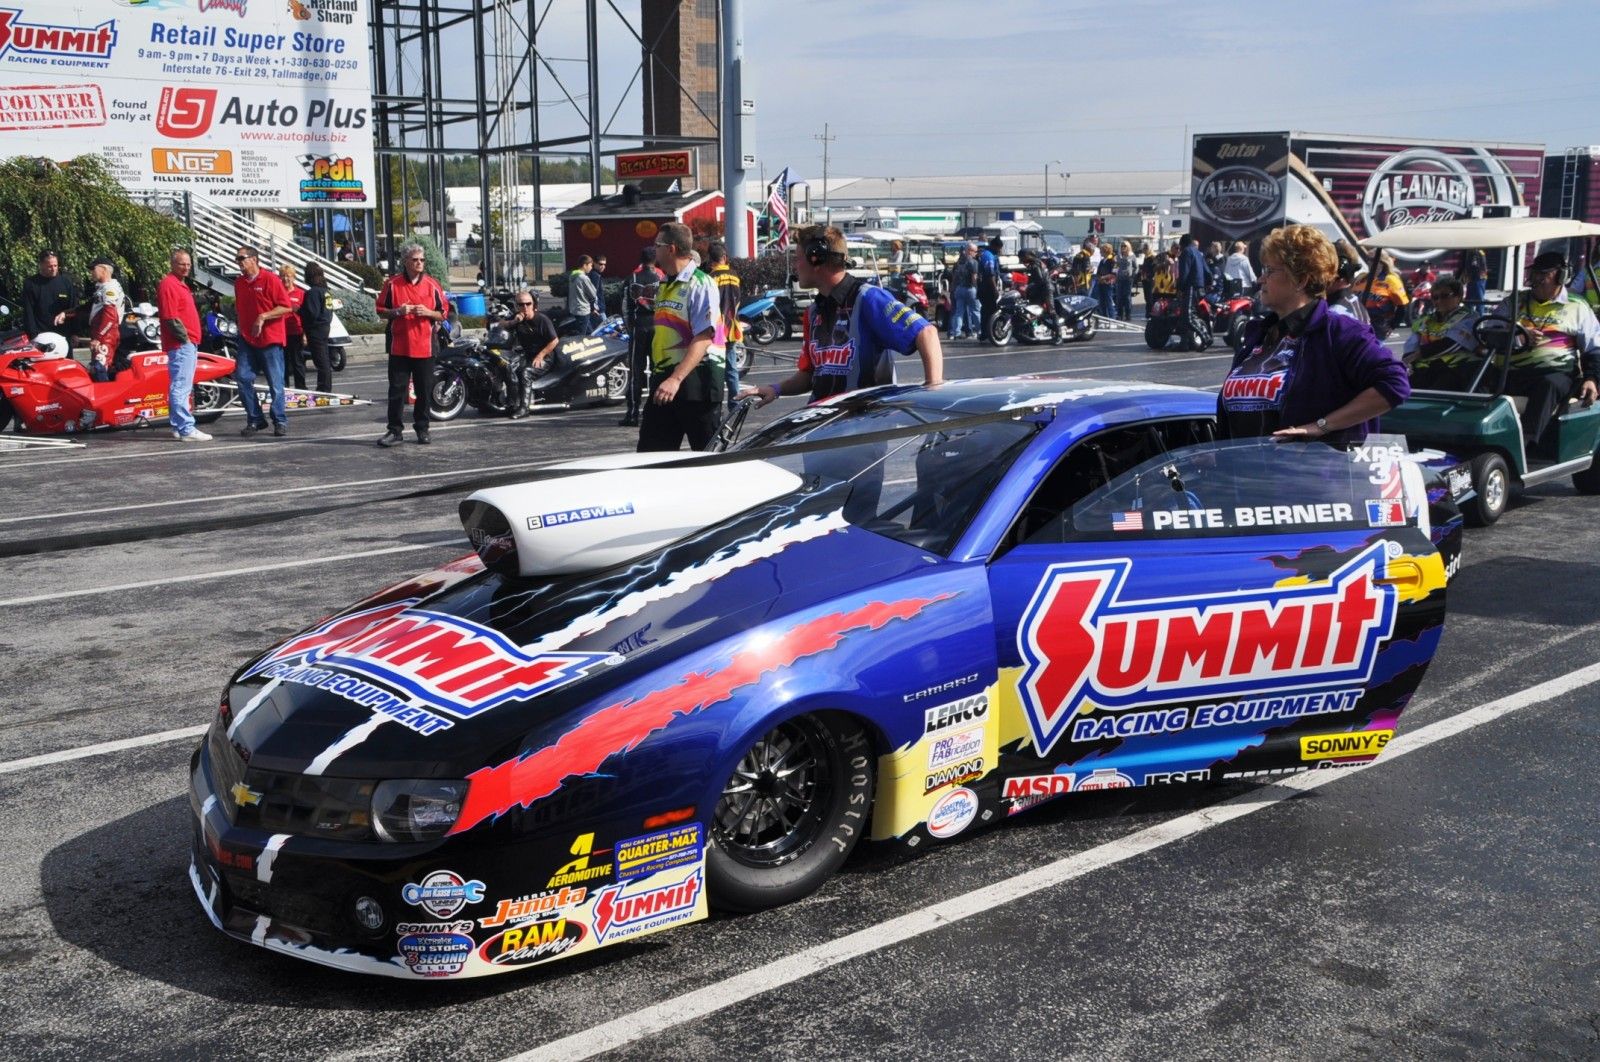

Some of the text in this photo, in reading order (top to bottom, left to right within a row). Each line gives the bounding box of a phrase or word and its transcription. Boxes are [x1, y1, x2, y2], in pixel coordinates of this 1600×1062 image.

[317, 10, 353, 25] Sharp
[150, 22, 345, 53] Retail Super Store
[8, 55, 110, 69] RACING EQUIPMENT
[138, 48, 145, 58] 9
[177, 53, 193, 62] pm
[202, 52, 209, 62] 7
[212, 53, 235, 64] Days
[245, 55, 271, 65] Week
[281, 57, 358, 70] 1-330-630-0250
[162, 63, 212, 75] Interstate
[324, 72, 338, 80] OH
[0, 93, 95, 111] COUNTER
[112, 99, 147, 110] found
[110, 112, 151, 123] only at
[219, 96, 367, 129] Auto Plus
[240, 131, 348, 143] www.autoplus.biz
[166, 151, 218, 171] NOS
[1217, 143, 1265, 160] Qatar
[153, 175, 191, 183] FILLING
[301, 180, 363, 189] performance
[209, 188, 281, 197] WAREHOUSE
[302, 191, 328, 200] parts
[1223, 375, 1283, 401] UMMIT
[545, 503, 633, 525] BRASWELL
[1152, 503, 1354, 531] PETE BERNER
[903, 672, 980, 703] CAMARO
[261, 661, 455, 736] RACING EQUIPMENT
[925, 695, 989, 734] LENCO
[1071, 689, 1365, 742] RACING EQUIPMENT
[934, 737, 954, 755] PRO
[1306, 733, 1390, 755] SONNY'S
[925, 758, 984, 791] DIAMOND
[1005, 776, 1070, 799] MSD
[617, 831, 698, 862] QUARTER-MAX
[546, 863, 613, 888] AEROMOTIVE
[515, 889, 555, 903] JERRY
[397, 921, 472, 933] SONNY'S
[608, 911, 694, 940] RACING EQUIPMENT
[501, 918, 567, 954] RAM
[429, 943, 469, 952] STOCK
[419, 952, 468, 965] SECOND
